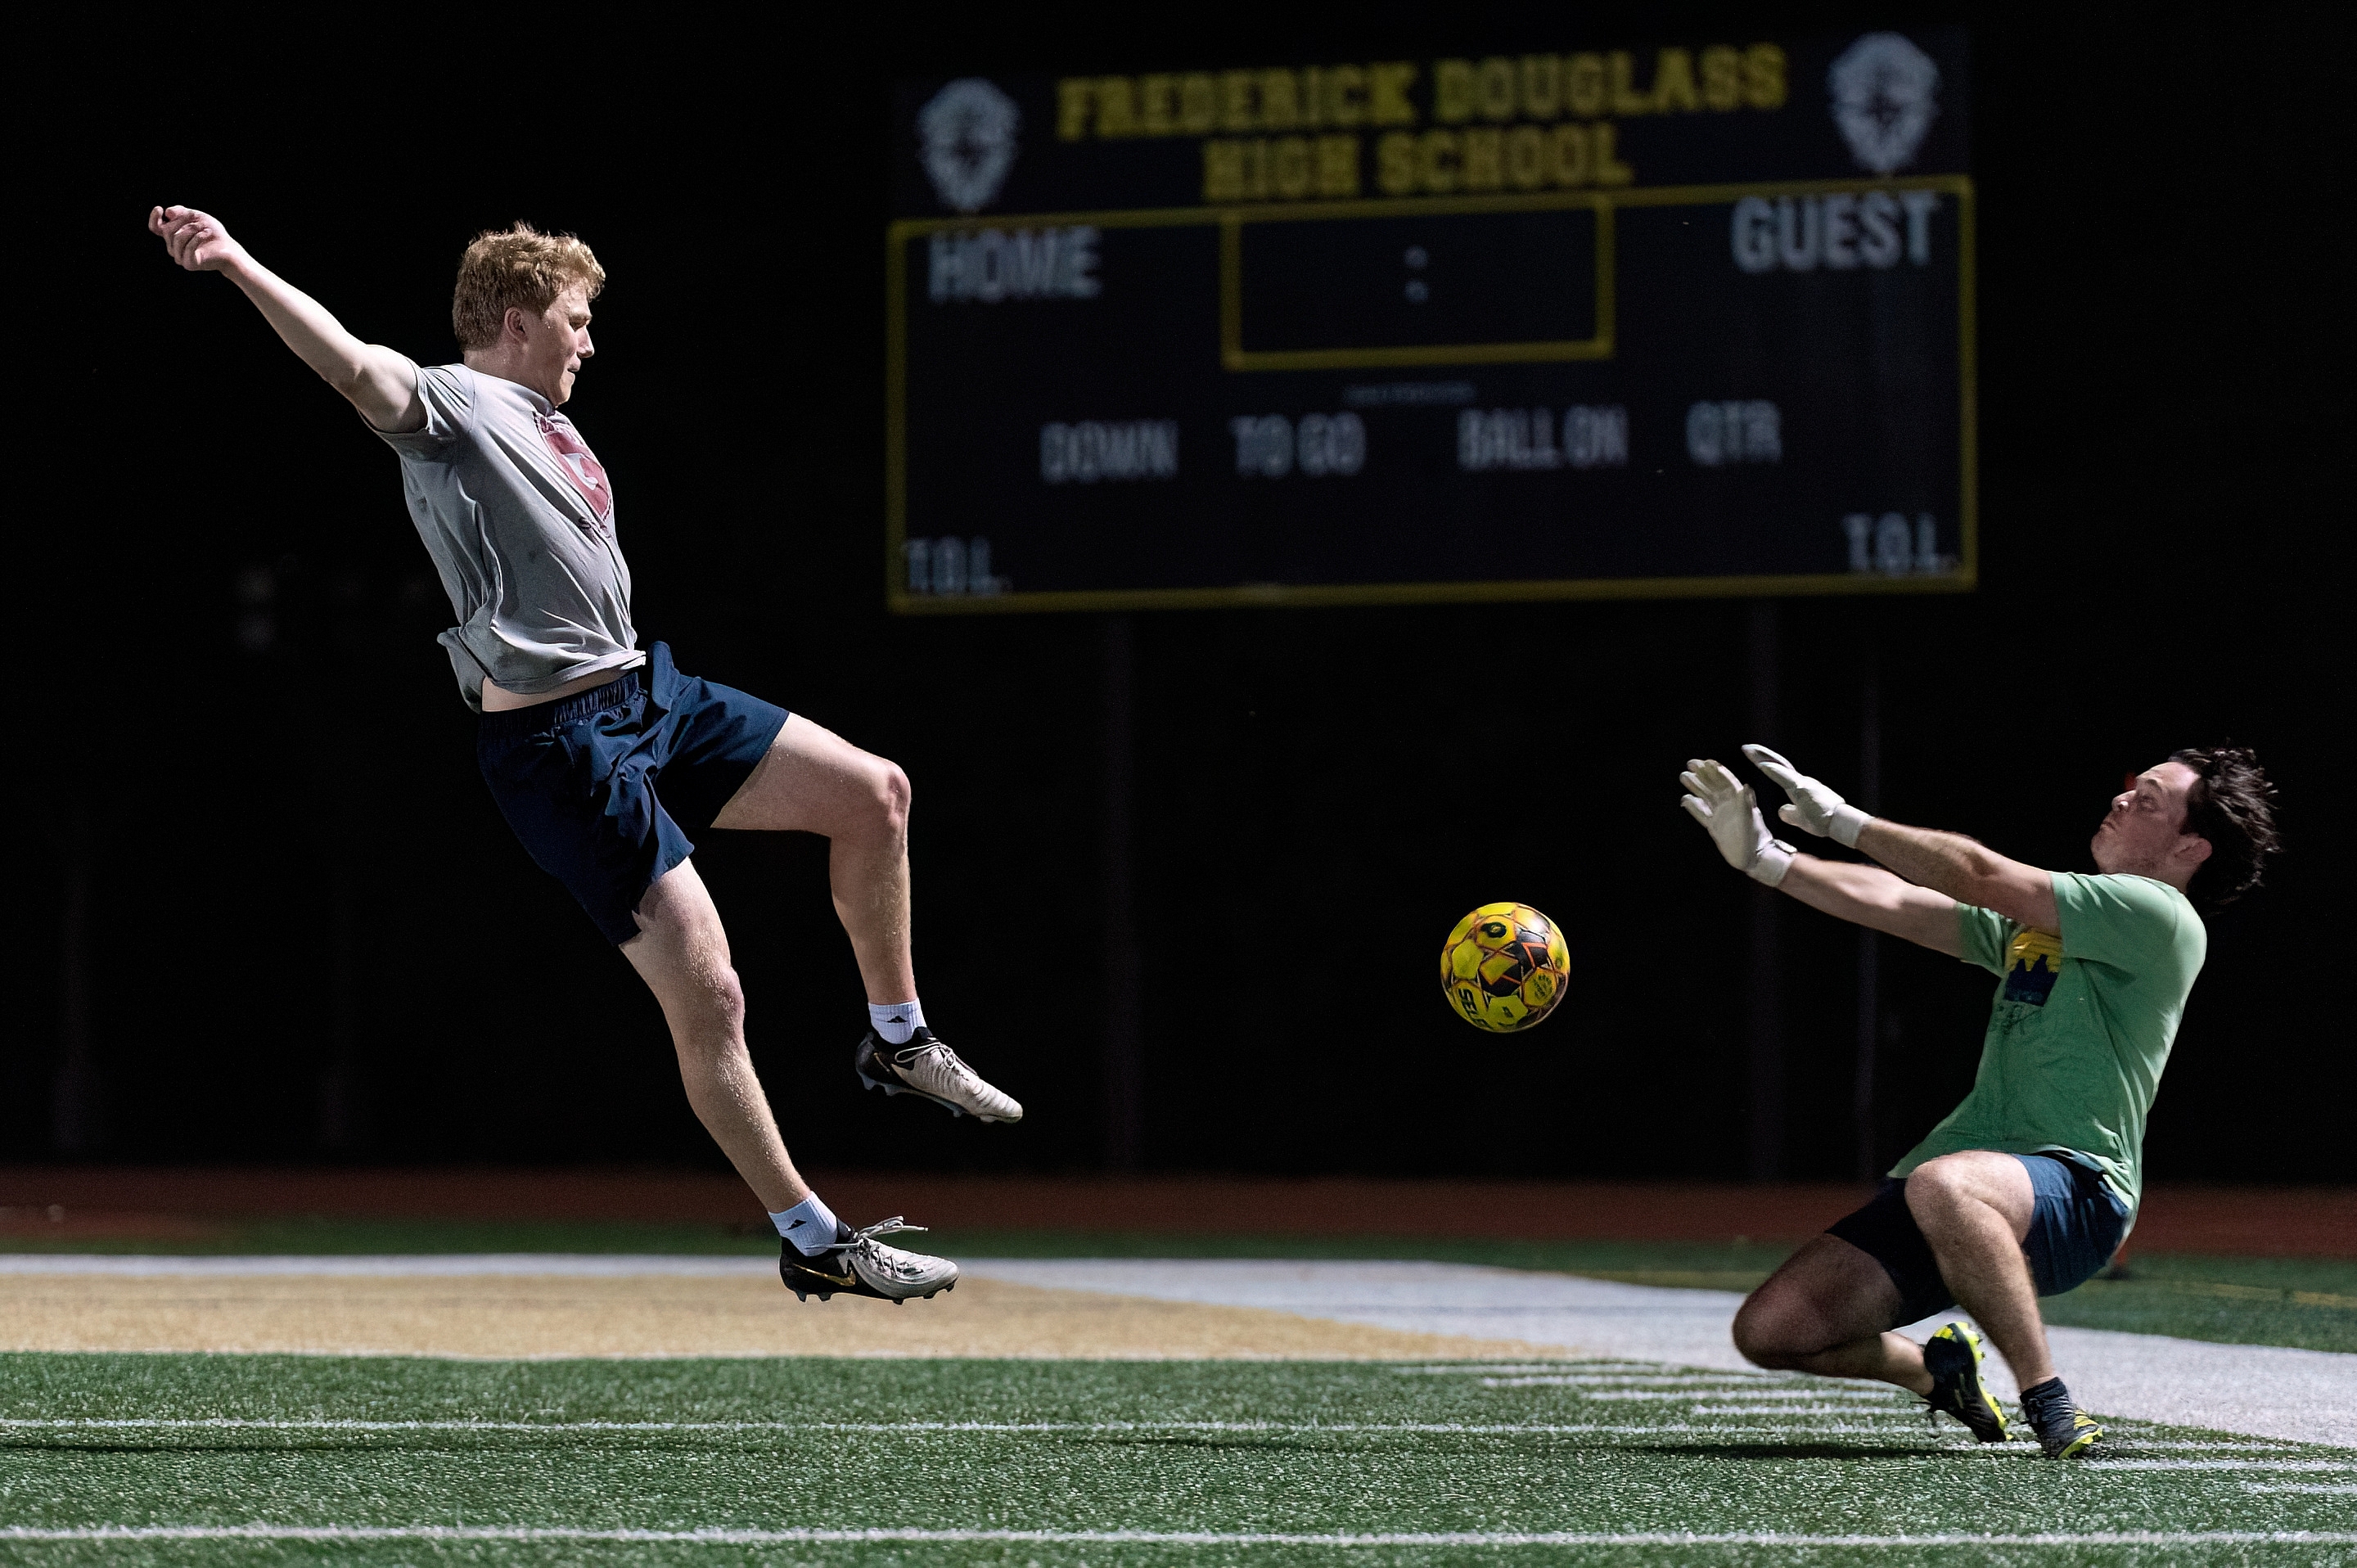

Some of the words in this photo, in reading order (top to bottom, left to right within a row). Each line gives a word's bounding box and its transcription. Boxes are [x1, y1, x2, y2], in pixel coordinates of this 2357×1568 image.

[1058, 62, 1417, 142] FREDERICK
[1434, 43, 1787, 122] DOUGLASS
[1202, 133, 1360, 201] HIGH
[1377, 122, 1633, 193] SCHOOL
[928, 226, 1101, 302] HOME
[1730, 189, 1938, 273] GUEST
[1040, 421, 1178, 481] DOWN
[1232, 414, 1293, 477] TO
[1298, 412, 1365, 476] GO
[1458, 408, 1562, 470] BALL
[1563, 404, 1628, 466] ON
[1686, 400, 1781, 465] QTR
